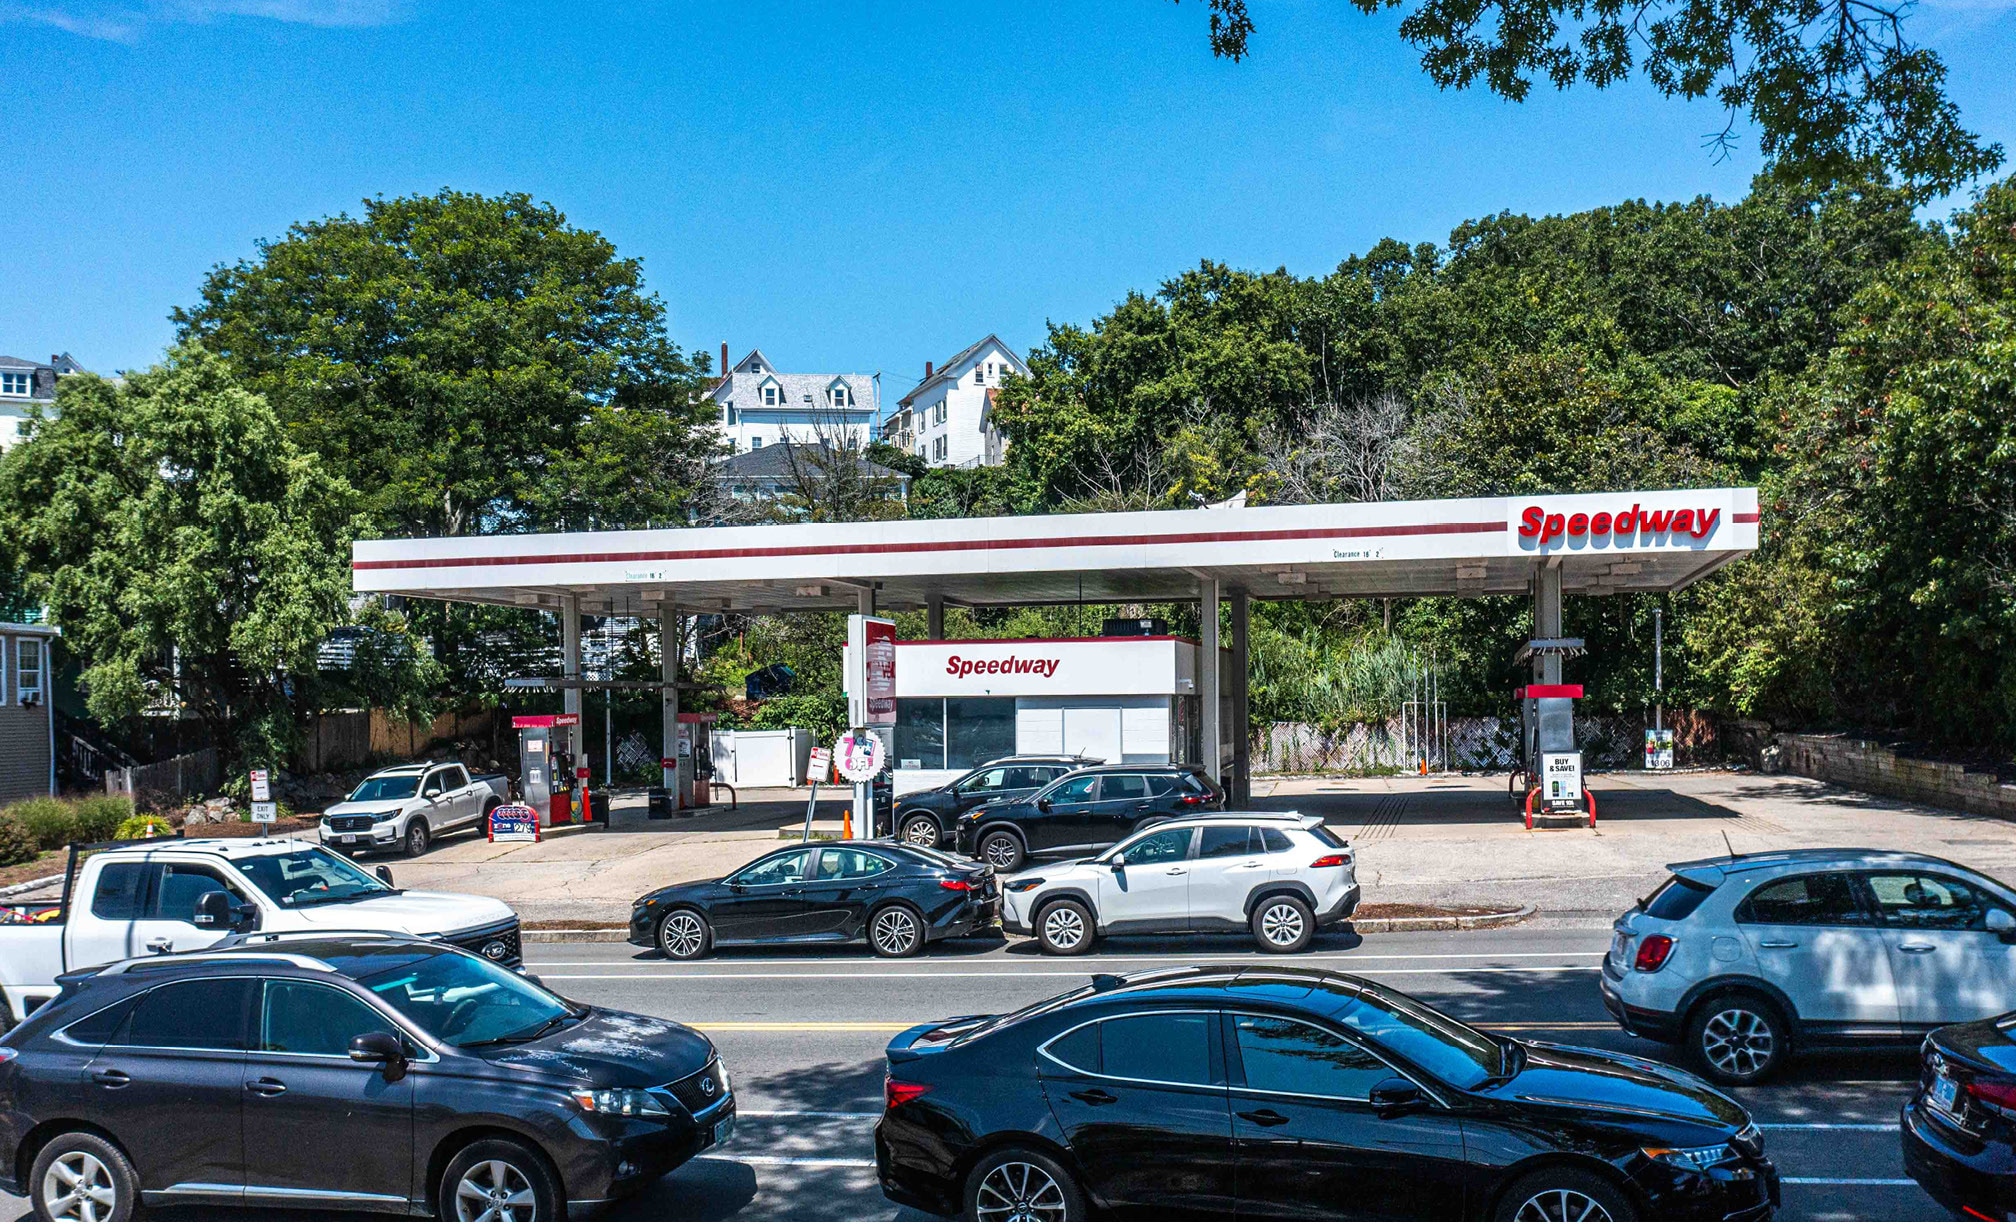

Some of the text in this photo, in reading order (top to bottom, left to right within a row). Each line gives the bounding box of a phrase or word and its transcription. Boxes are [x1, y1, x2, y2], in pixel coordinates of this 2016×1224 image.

[1518, 503, 1721, 544] Speedway
[1333, 550, 1360, 558] Clearance
[946, 655, 1060, 679] Speedway
[556, 716, 578, 726] Speedway
[845, 757, 873, 771] OFF
